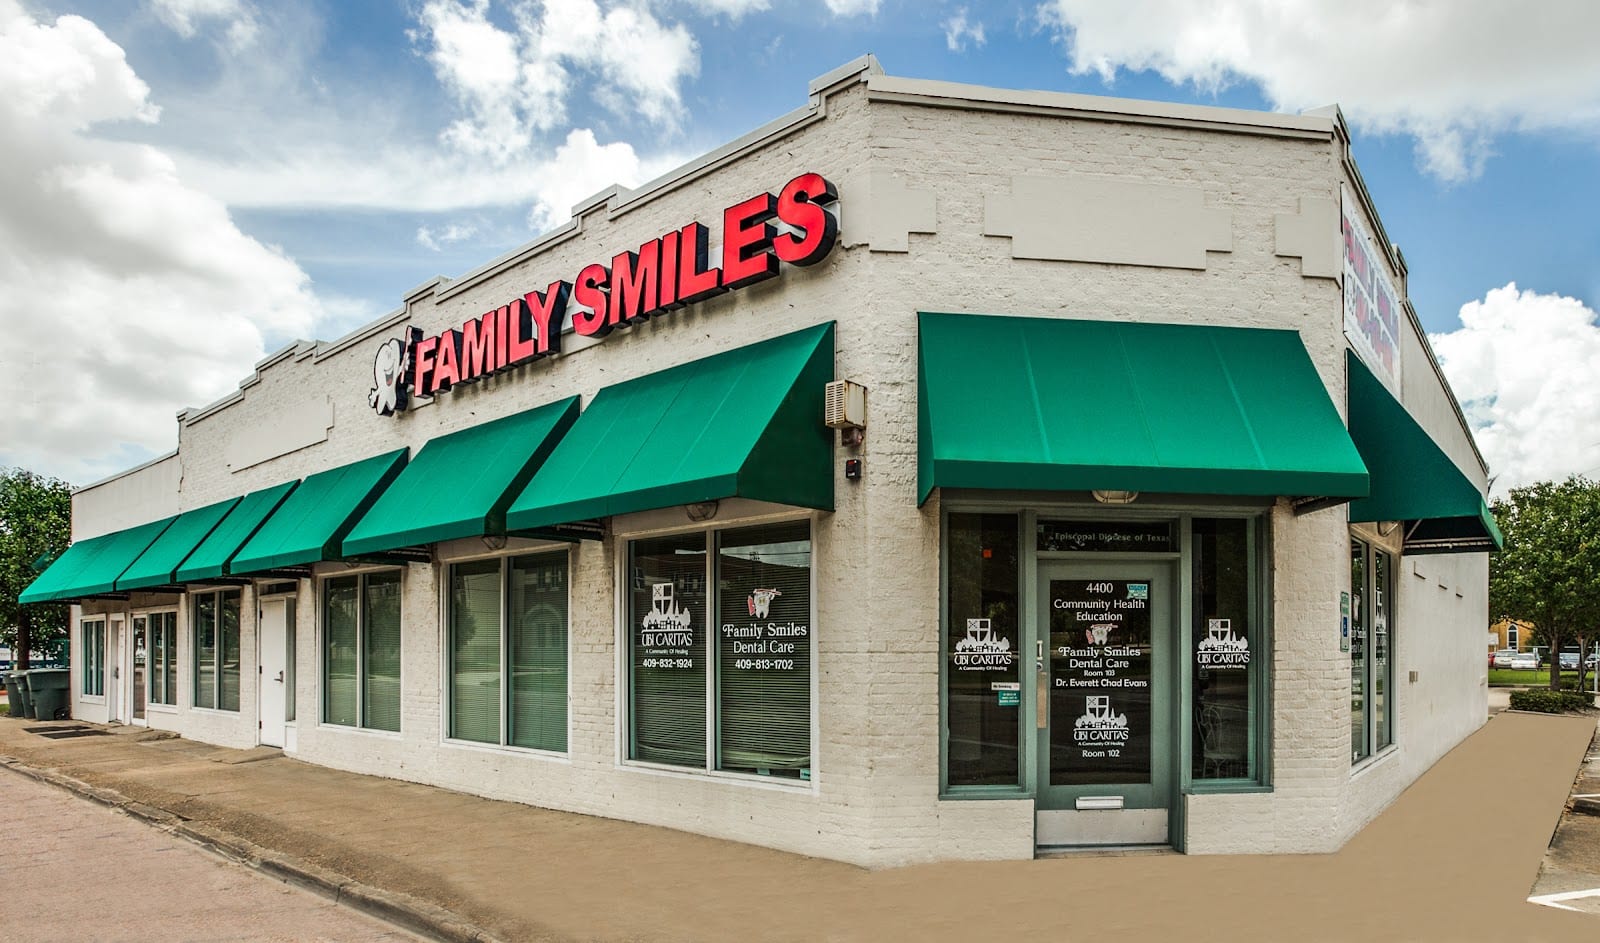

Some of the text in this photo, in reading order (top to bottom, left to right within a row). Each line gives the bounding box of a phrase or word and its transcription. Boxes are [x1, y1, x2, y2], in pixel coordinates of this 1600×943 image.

[414, 172, 838, 398] FAMILY SMILES
[1055, 532, 1170, 542] Episcopal Diocese of Texas
[1086, 582, 1114, 594] 4400
[1054, 598, 1145, 610] Community Health
[1076, 612, 1122, 621] Education
[722, 622, 807, 638] Family Smiles
[642, 633, 692, 646] UBI CARITAS
[734, 640, 794, 654] Dental Care
[1058, 646, 1140, 658] Family Smiles
[642, 658, 692, 668] 409-832-1924
[954, 655, 1012, 665] UBI CARITAS
[1070, 659, 1129, 669] Dental Care
[1197, 654, 1250, 663] UBI CARITAS
[735, 659, 794, 670] 409-813-1702
[1070, 679, 1099, 687] Everett
[1101, 679, 1122, 687] Chad
[1074, 730, 1128, 741] UBI CARITAS
